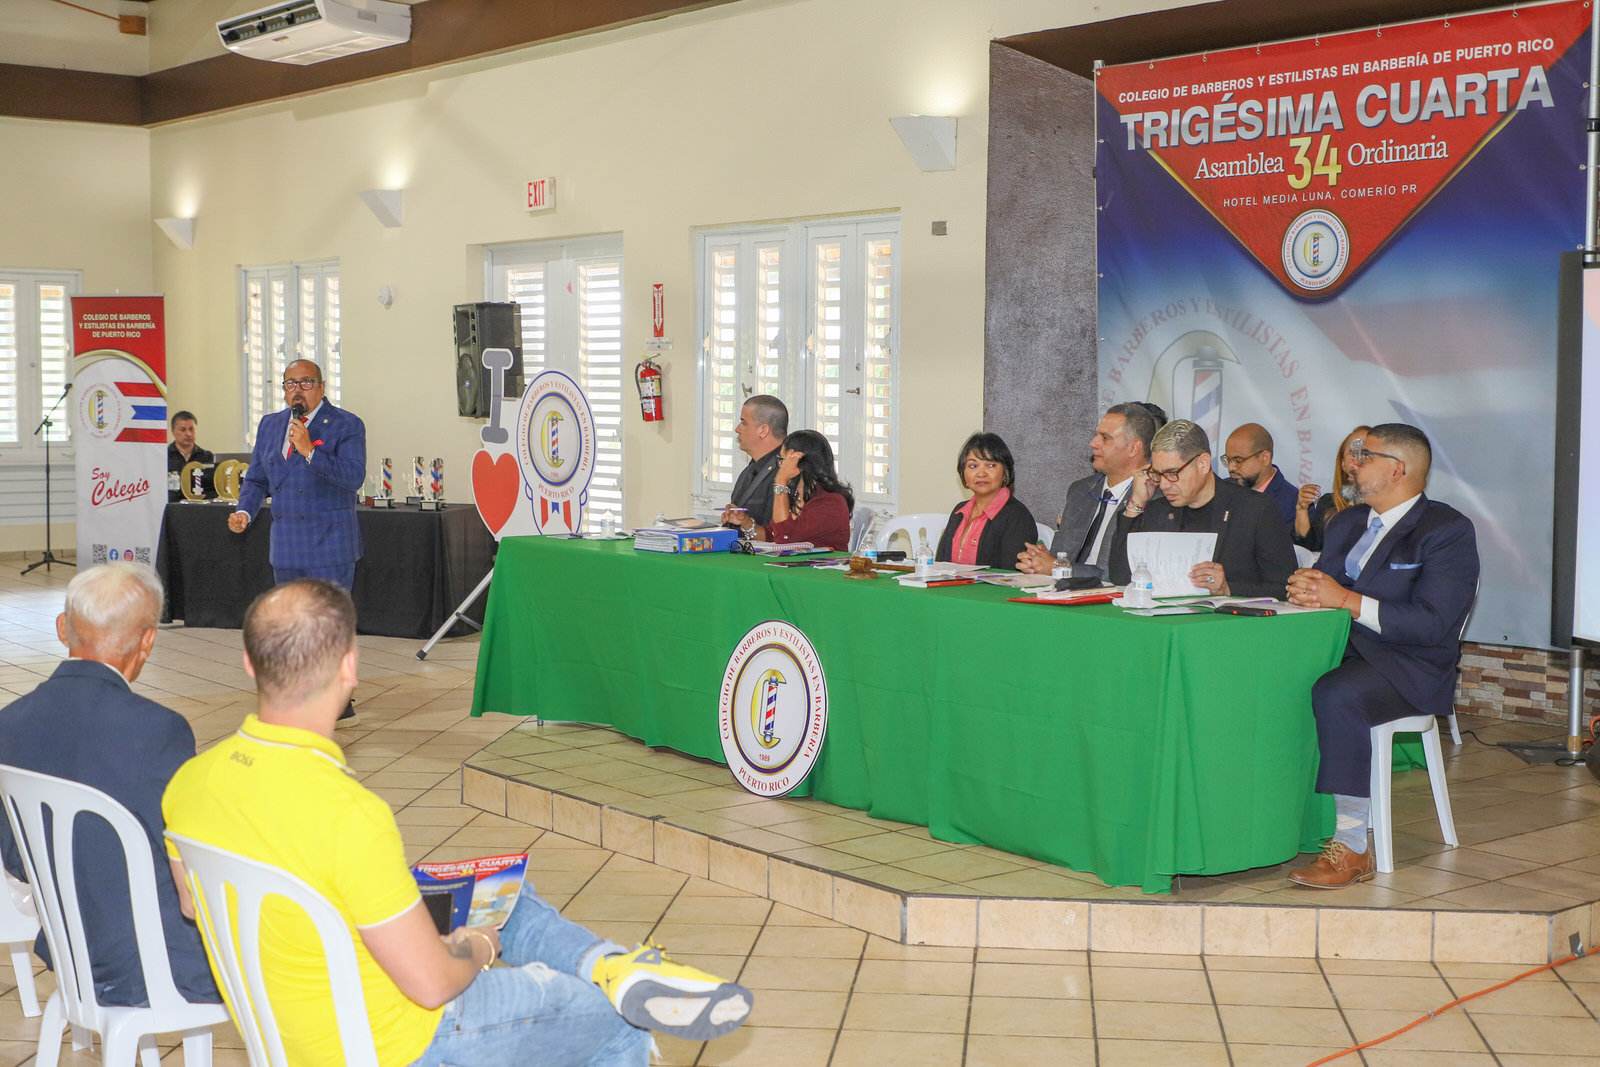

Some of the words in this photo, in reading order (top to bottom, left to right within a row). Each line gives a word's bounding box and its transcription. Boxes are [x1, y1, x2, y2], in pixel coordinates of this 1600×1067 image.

[1118, 88, 1170, 103] COLEGIO
[1172, 85, 1188, 97] DE
[1191, 77, 1254, 95] BARBEROS
[1257, 76, 1266, 87] Y
[1268, 66, 1338, 86] ESTILISTAS
[1342, 63, 1360, 76] EN
[1363, 52, 1429, 73] BARBERÍA
[1433, 50, 1452, 63] DE
[1456, 43, 1513, 61] PUERTO
[1517, 37, 1554, 53] RICO
[1119, 90, 1345, 151] TRIGÉSIMA
[1355, 65, 1555, 128] CUARTA
[1194, 152, 1285, 180] Asamblea
[1287, 134, 1343, 190] 34
[1347, 135, 1449, 167] Ordinaria
[527, 180, 546, 208] EXIT
[1223, 195, 1258, 207] HOTEL
[1262, 193, 1298, 205] MEDIA
[1341, 184, 1397, 199] COMERÍO
[1402, 183, 1418, 194] PR
[126, 321, 156, 329] BARBERÍA
[1108, 299, 1188, 384] BARBEROS
[1188, 298, 1200, 314] Y
[1206, 300, 1300, 379] ESTILISTAS
[1290, 385, 1311, 422] EN
[92, 467, 110, 481] Soy
[91, 478, 150, 506] Colegio
[538, 483, 560, 499] PUERTO
[560, 486, 575, 498] RICO
[721, 683, 731, 740] COLEGIO
[727, 666, 736, 681] DE
[735, 629, 771, 665] BARBEROS
[772, 627, 779, 637] Y
[779, 628, 817, 675] ESTILISTAS
[812, 674, 821, 692] EN
[738, 766, 768, 791] PUERTO
[769, 776, 790, 792] RICO
